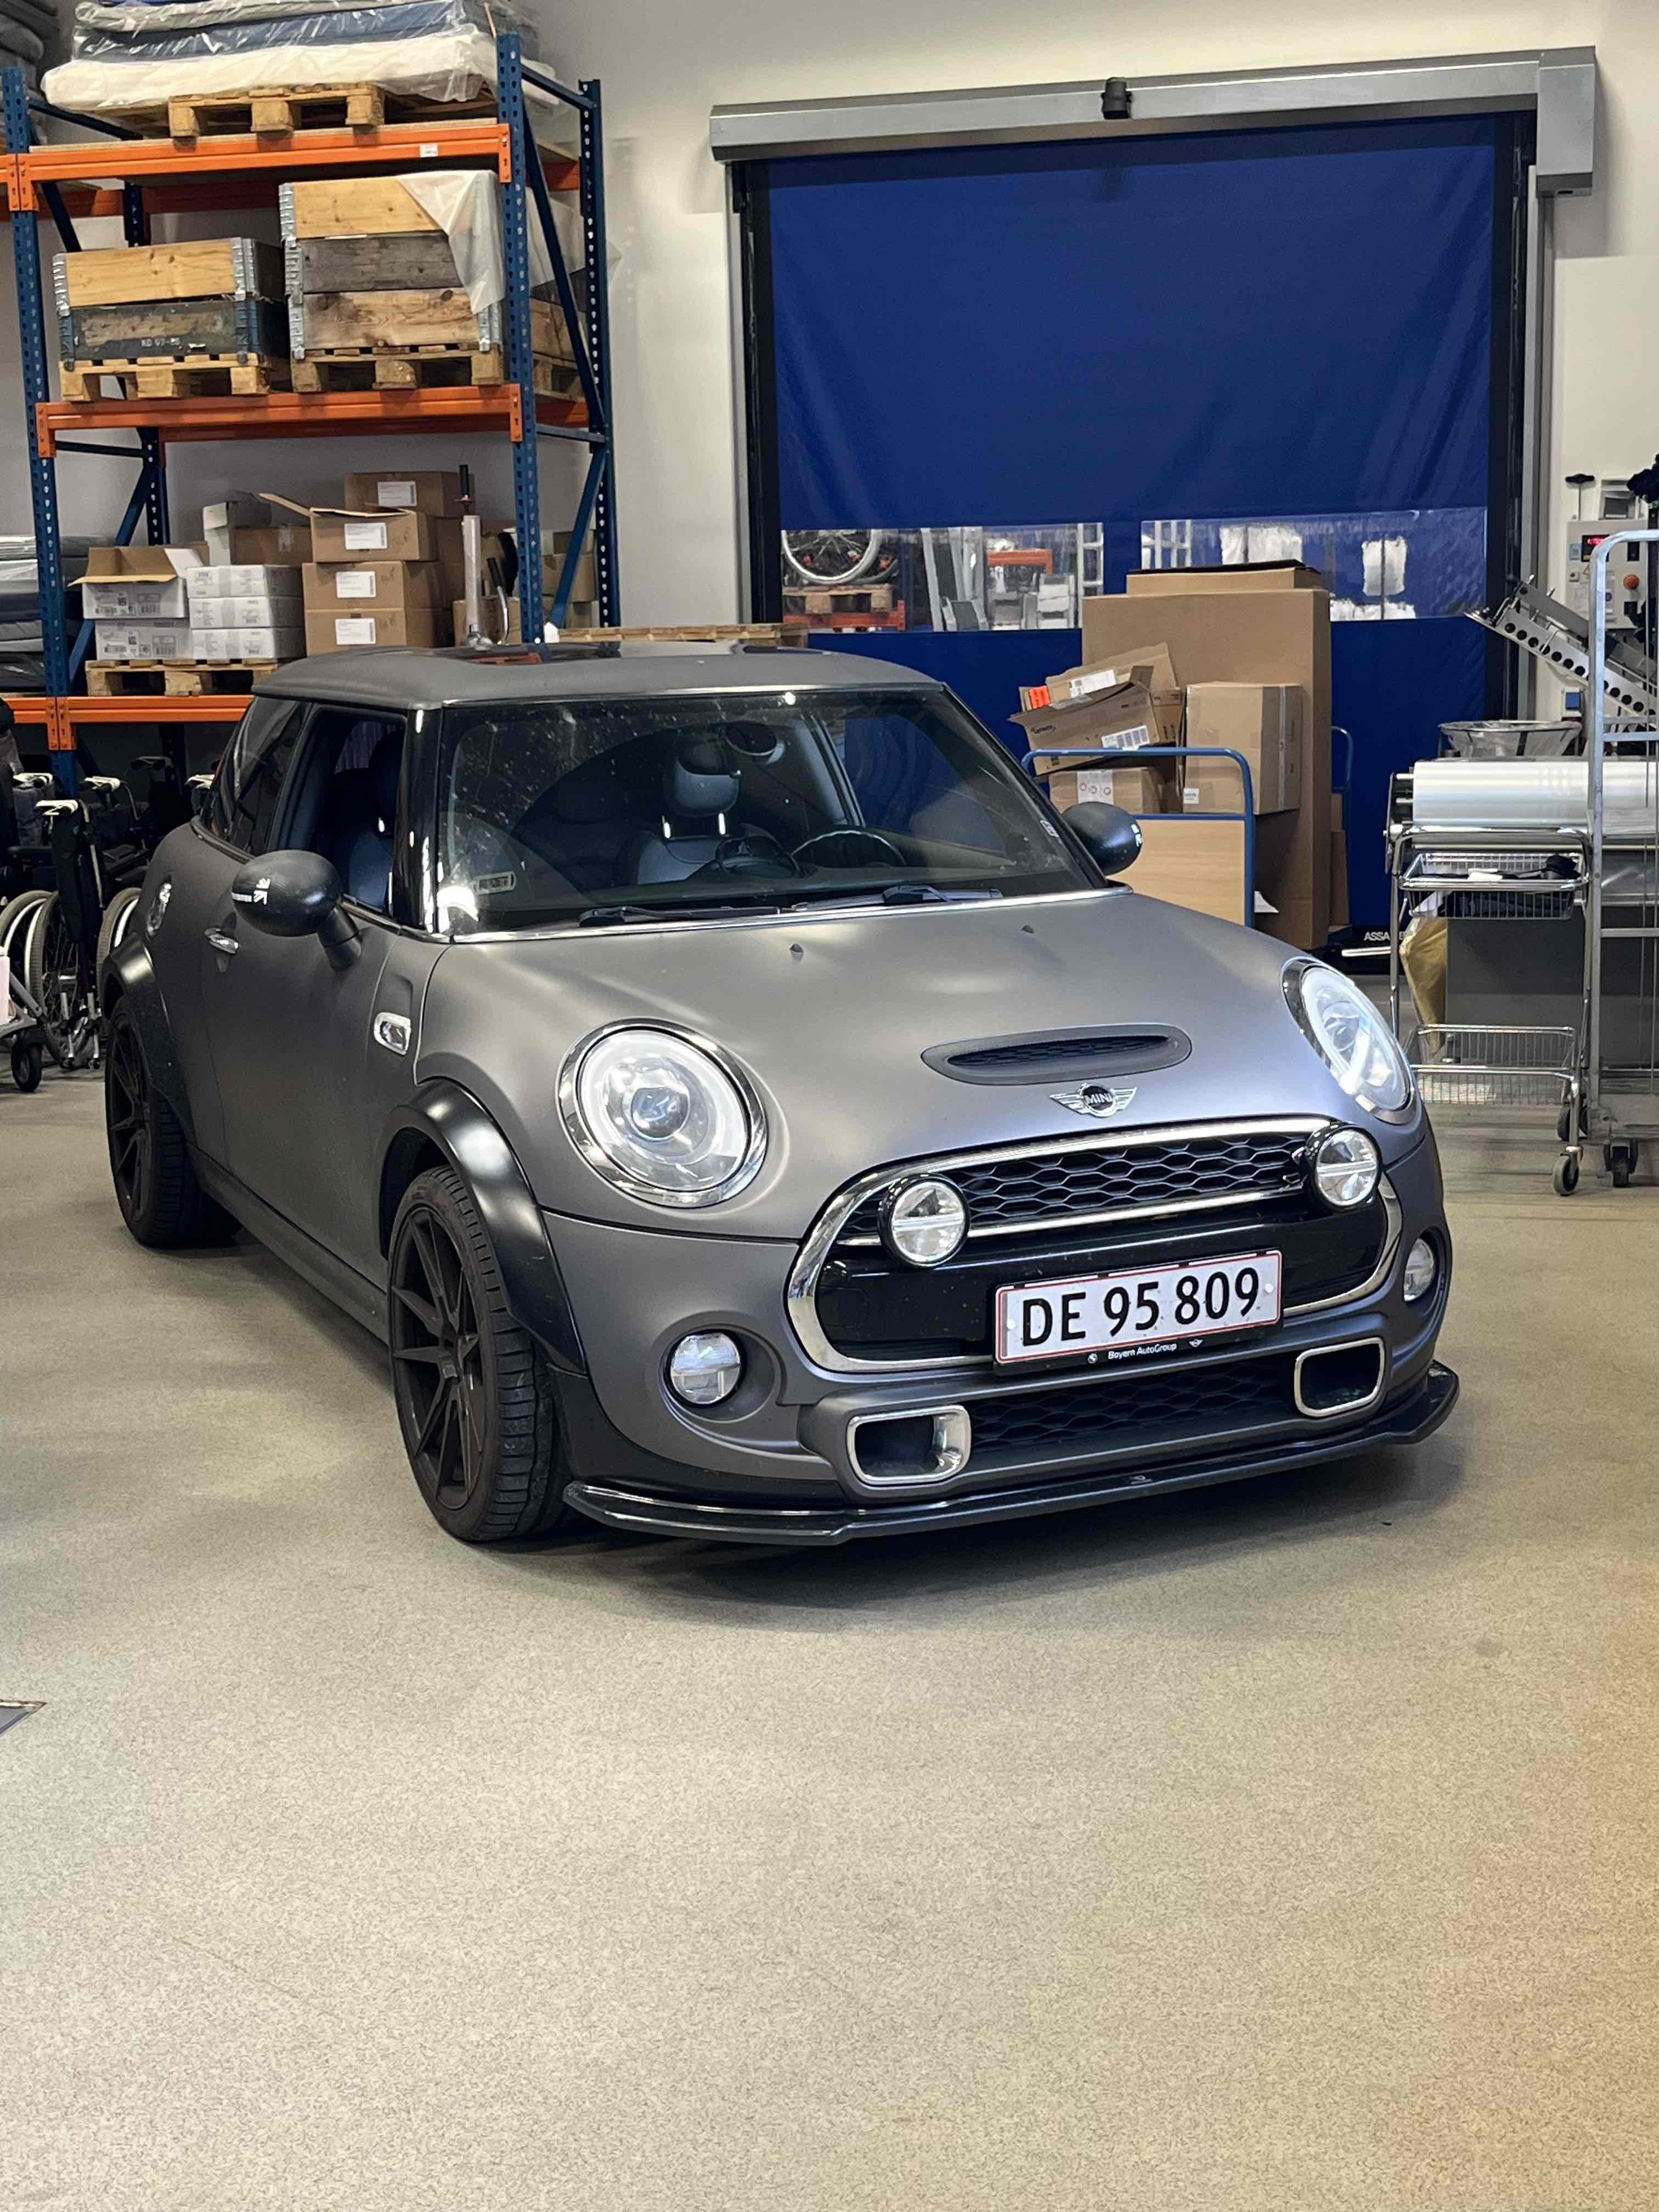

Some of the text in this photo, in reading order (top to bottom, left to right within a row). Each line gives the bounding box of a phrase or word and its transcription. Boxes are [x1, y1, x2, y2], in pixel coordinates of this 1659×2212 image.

[1363, 932, 1391, 941] ASSA
[1084, 1093, 1113, 1103] MINI
[1022, 1267, 1259, 1347] DE 95 809
[1108, 1343, 1177, 1360] Bayern AutoGroup
